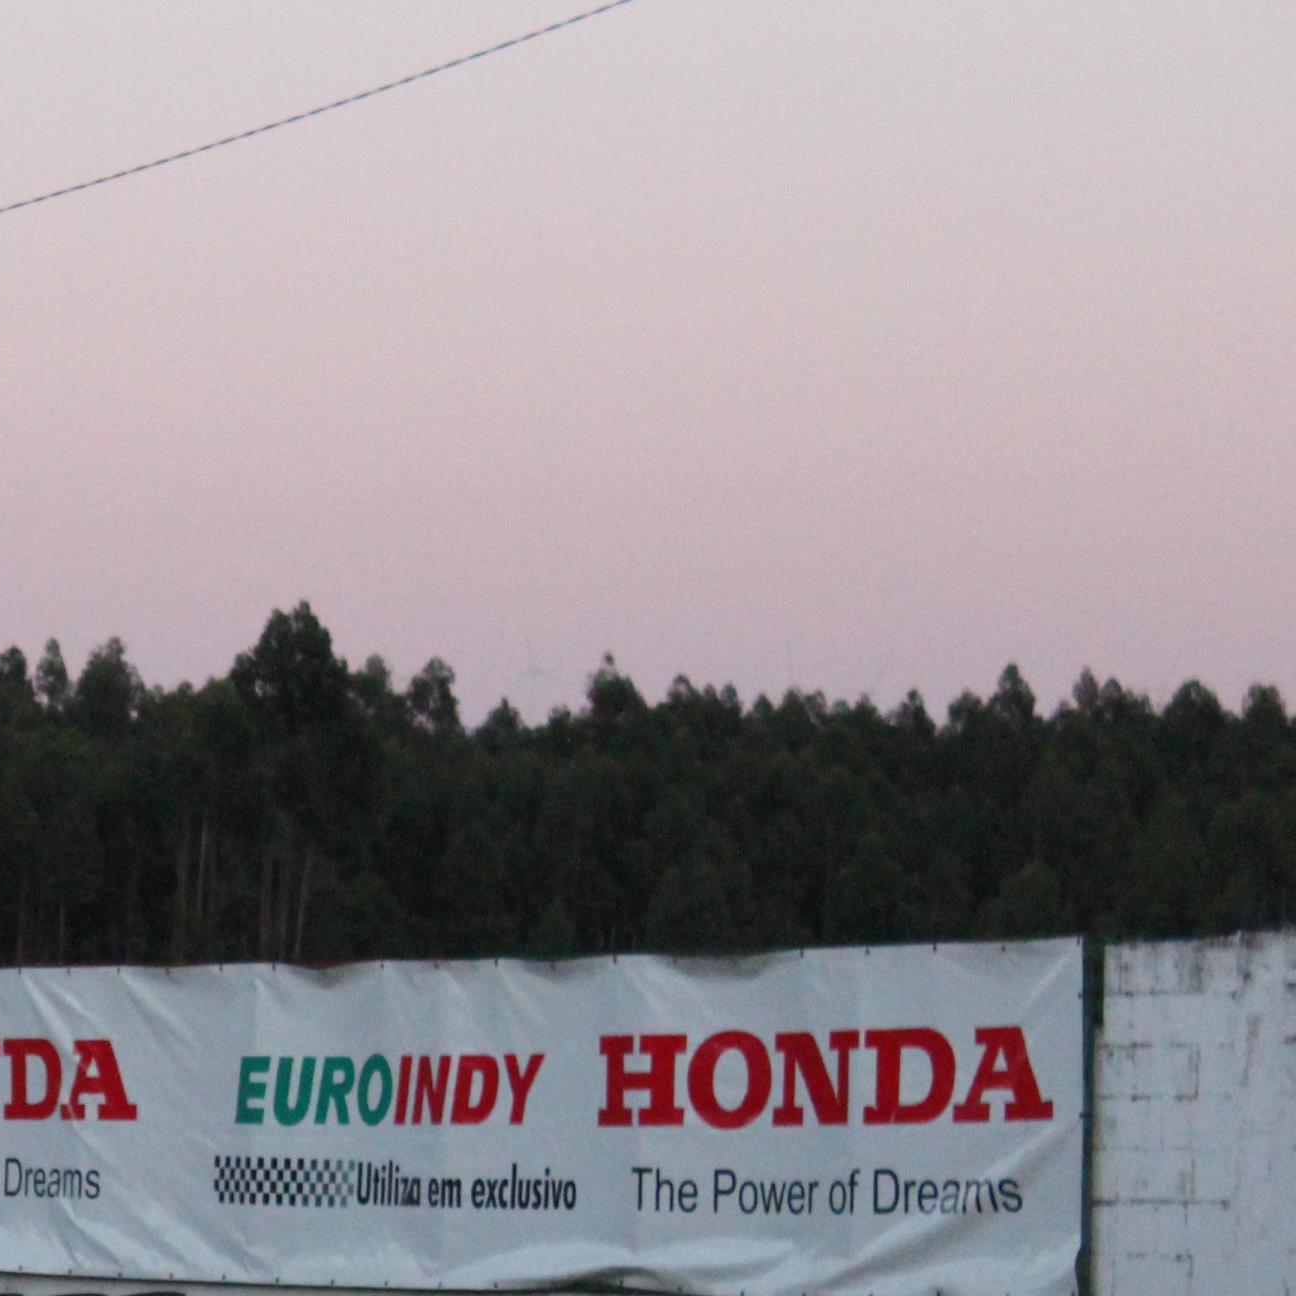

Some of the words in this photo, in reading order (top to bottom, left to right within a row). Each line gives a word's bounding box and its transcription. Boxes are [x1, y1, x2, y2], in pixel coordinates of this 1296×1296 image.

[235, 1053, 544, 1125] EUROINDY
[598, 1026, 1053, 1129] HONDA
[4, 1157, 101, 1200] Dreams
[356, 1161, 421, 1207] Utiliza
[427, 1177, 463, 1208] em
[470, 1163, 578, 1211] exclusivo
[631, 1167, 699, 1214] The
[712, 1168, 820, 1216] Power
[829, 1168, 862, 1216] of
[872, 1168, 1024, 1216] Dreams
